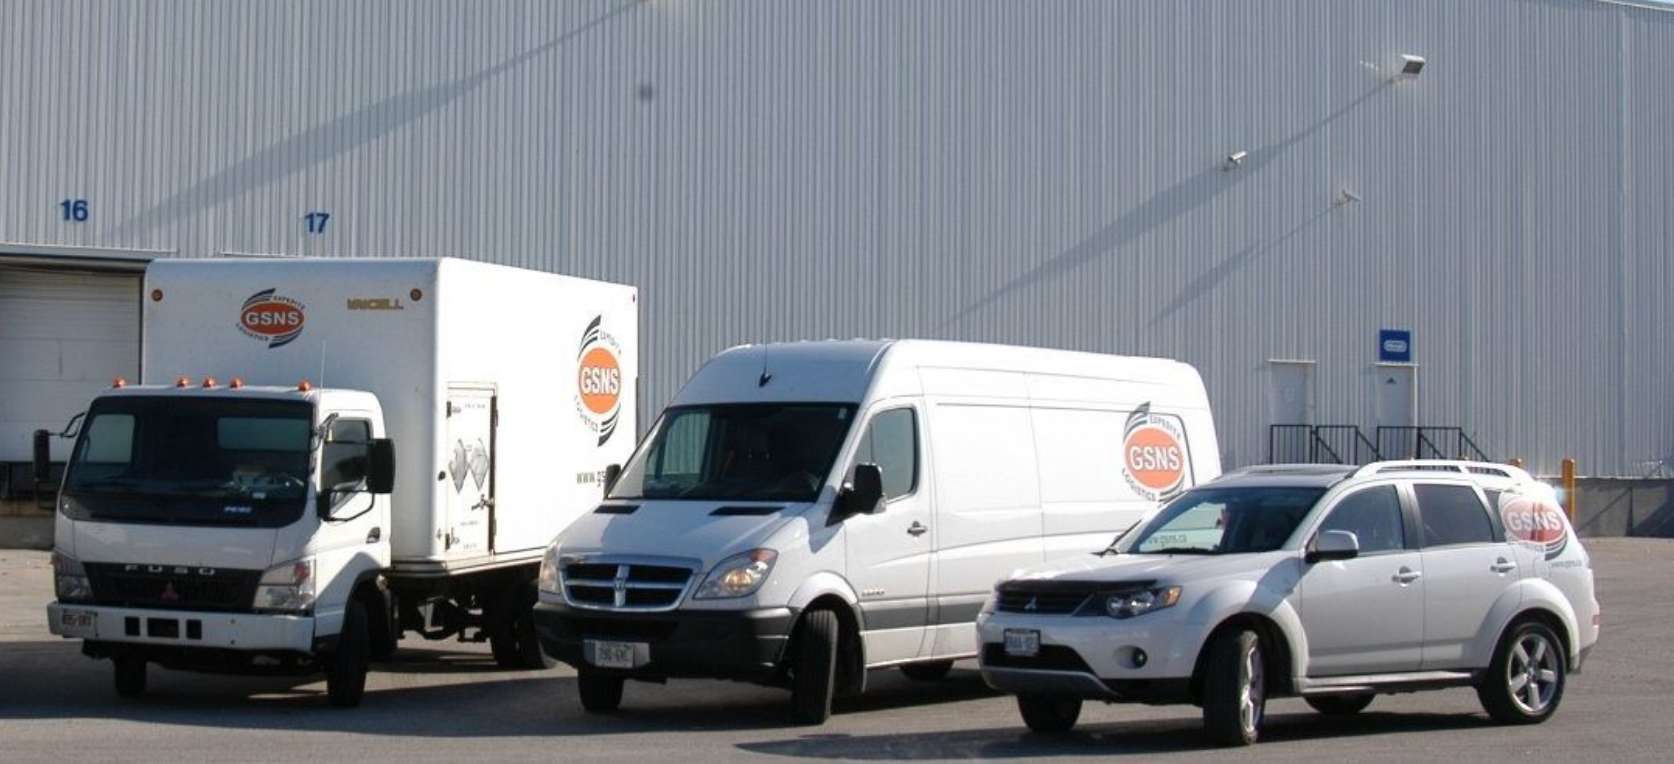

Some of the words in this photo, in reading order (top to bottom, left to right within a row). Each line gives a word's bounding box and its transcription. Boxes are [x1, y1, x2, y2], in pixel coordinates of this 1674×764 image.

[60, 199, 89, 222] 16
[305, 212, 330, 233] 17
[246, 311, 300, 326] GSNS
[583, 366, 619, 395] GSNS
[1130, 445, 1180, 470] GSNS
[1507, 510, 1560, 531] GSNS
[125, 564, 215, 575] FUSO
